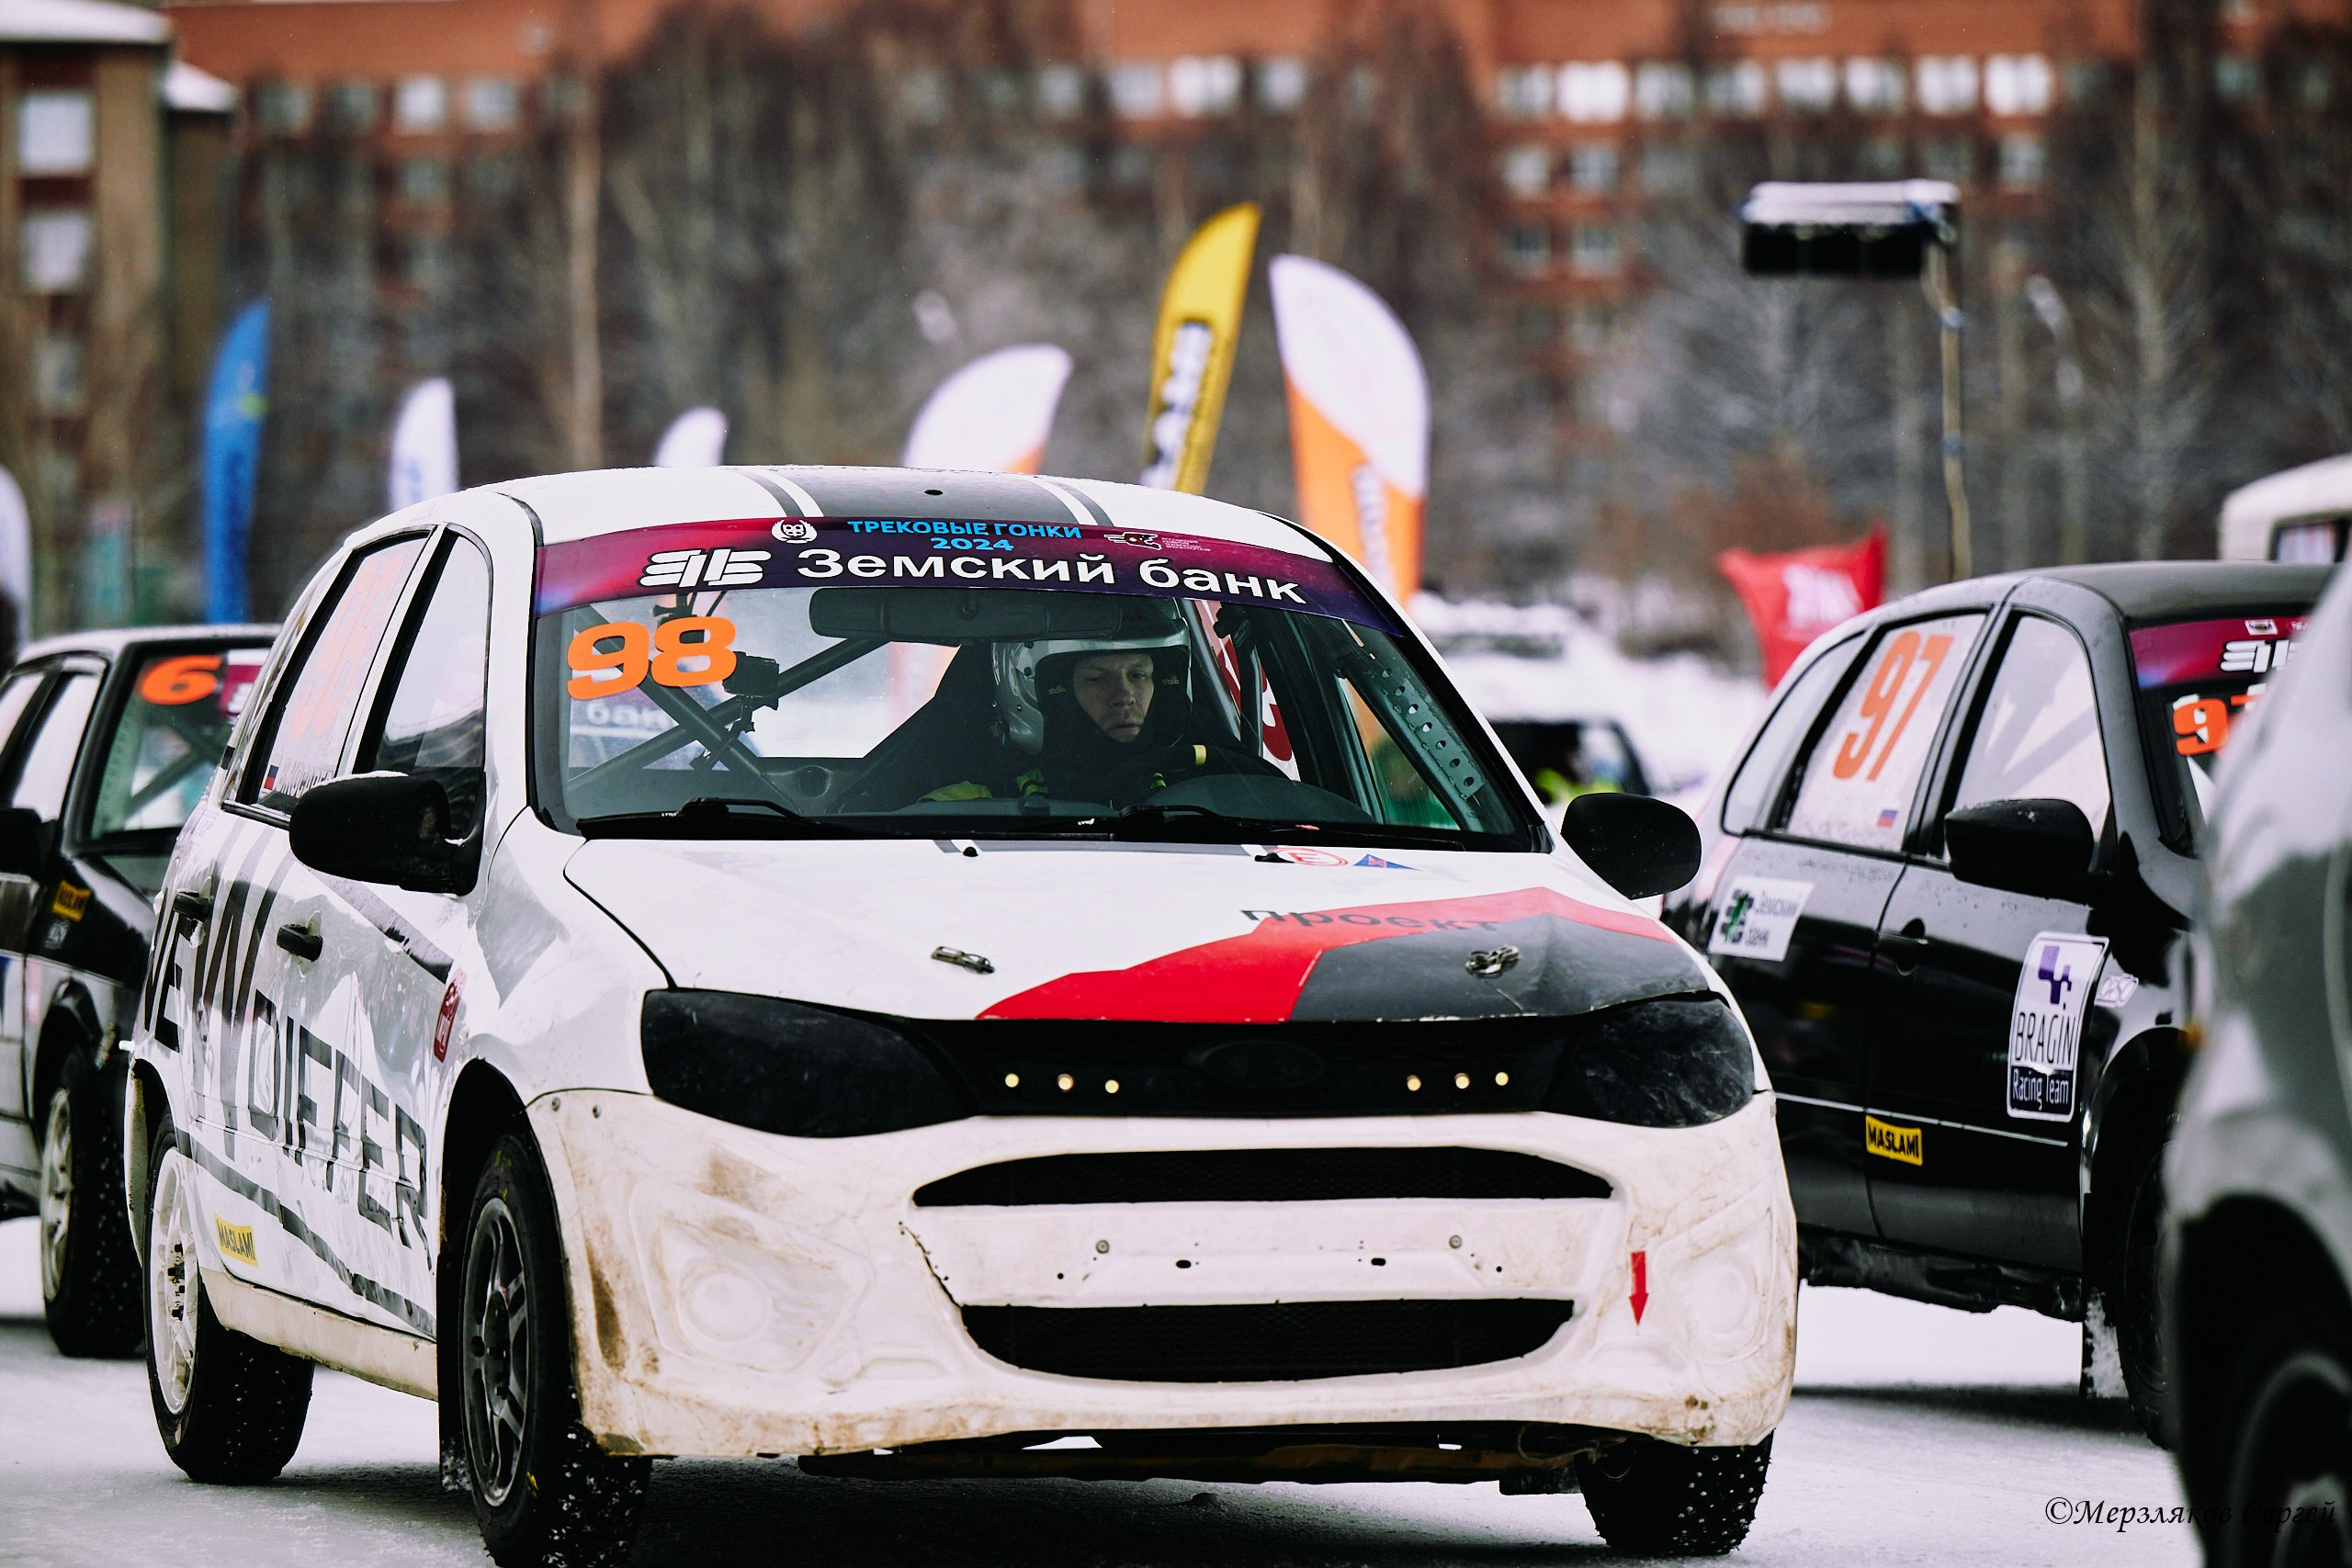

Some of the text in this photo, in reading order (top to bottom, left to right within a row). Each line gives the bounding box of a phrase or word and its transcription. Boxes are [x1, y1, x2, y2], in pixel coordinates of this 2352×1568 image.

[847, 520, 1082, 539] ТРЕКОВЫЕ ГОНКИ
[930, 536, 1014, 551] 2024
[797, 548, 1309, 604] Земский банк
[141, 655, 223, 705] 6
[567, 616, 737, 701] 98
[1834, 631, 1955, 783] 97
[2173, 694, 2262, 756] 9
[1240, 908, 1499, 931] проект
[2015, 1011, 2076, 1066] BRAGIN
[2012, 1067, 2044, 1111] Racing
[246, 987, 435, 1273] DIFFER
[1867, 1122, 1920, 1160] MASLAMI
[215, 1218, 256, 1261] MASLAMI
